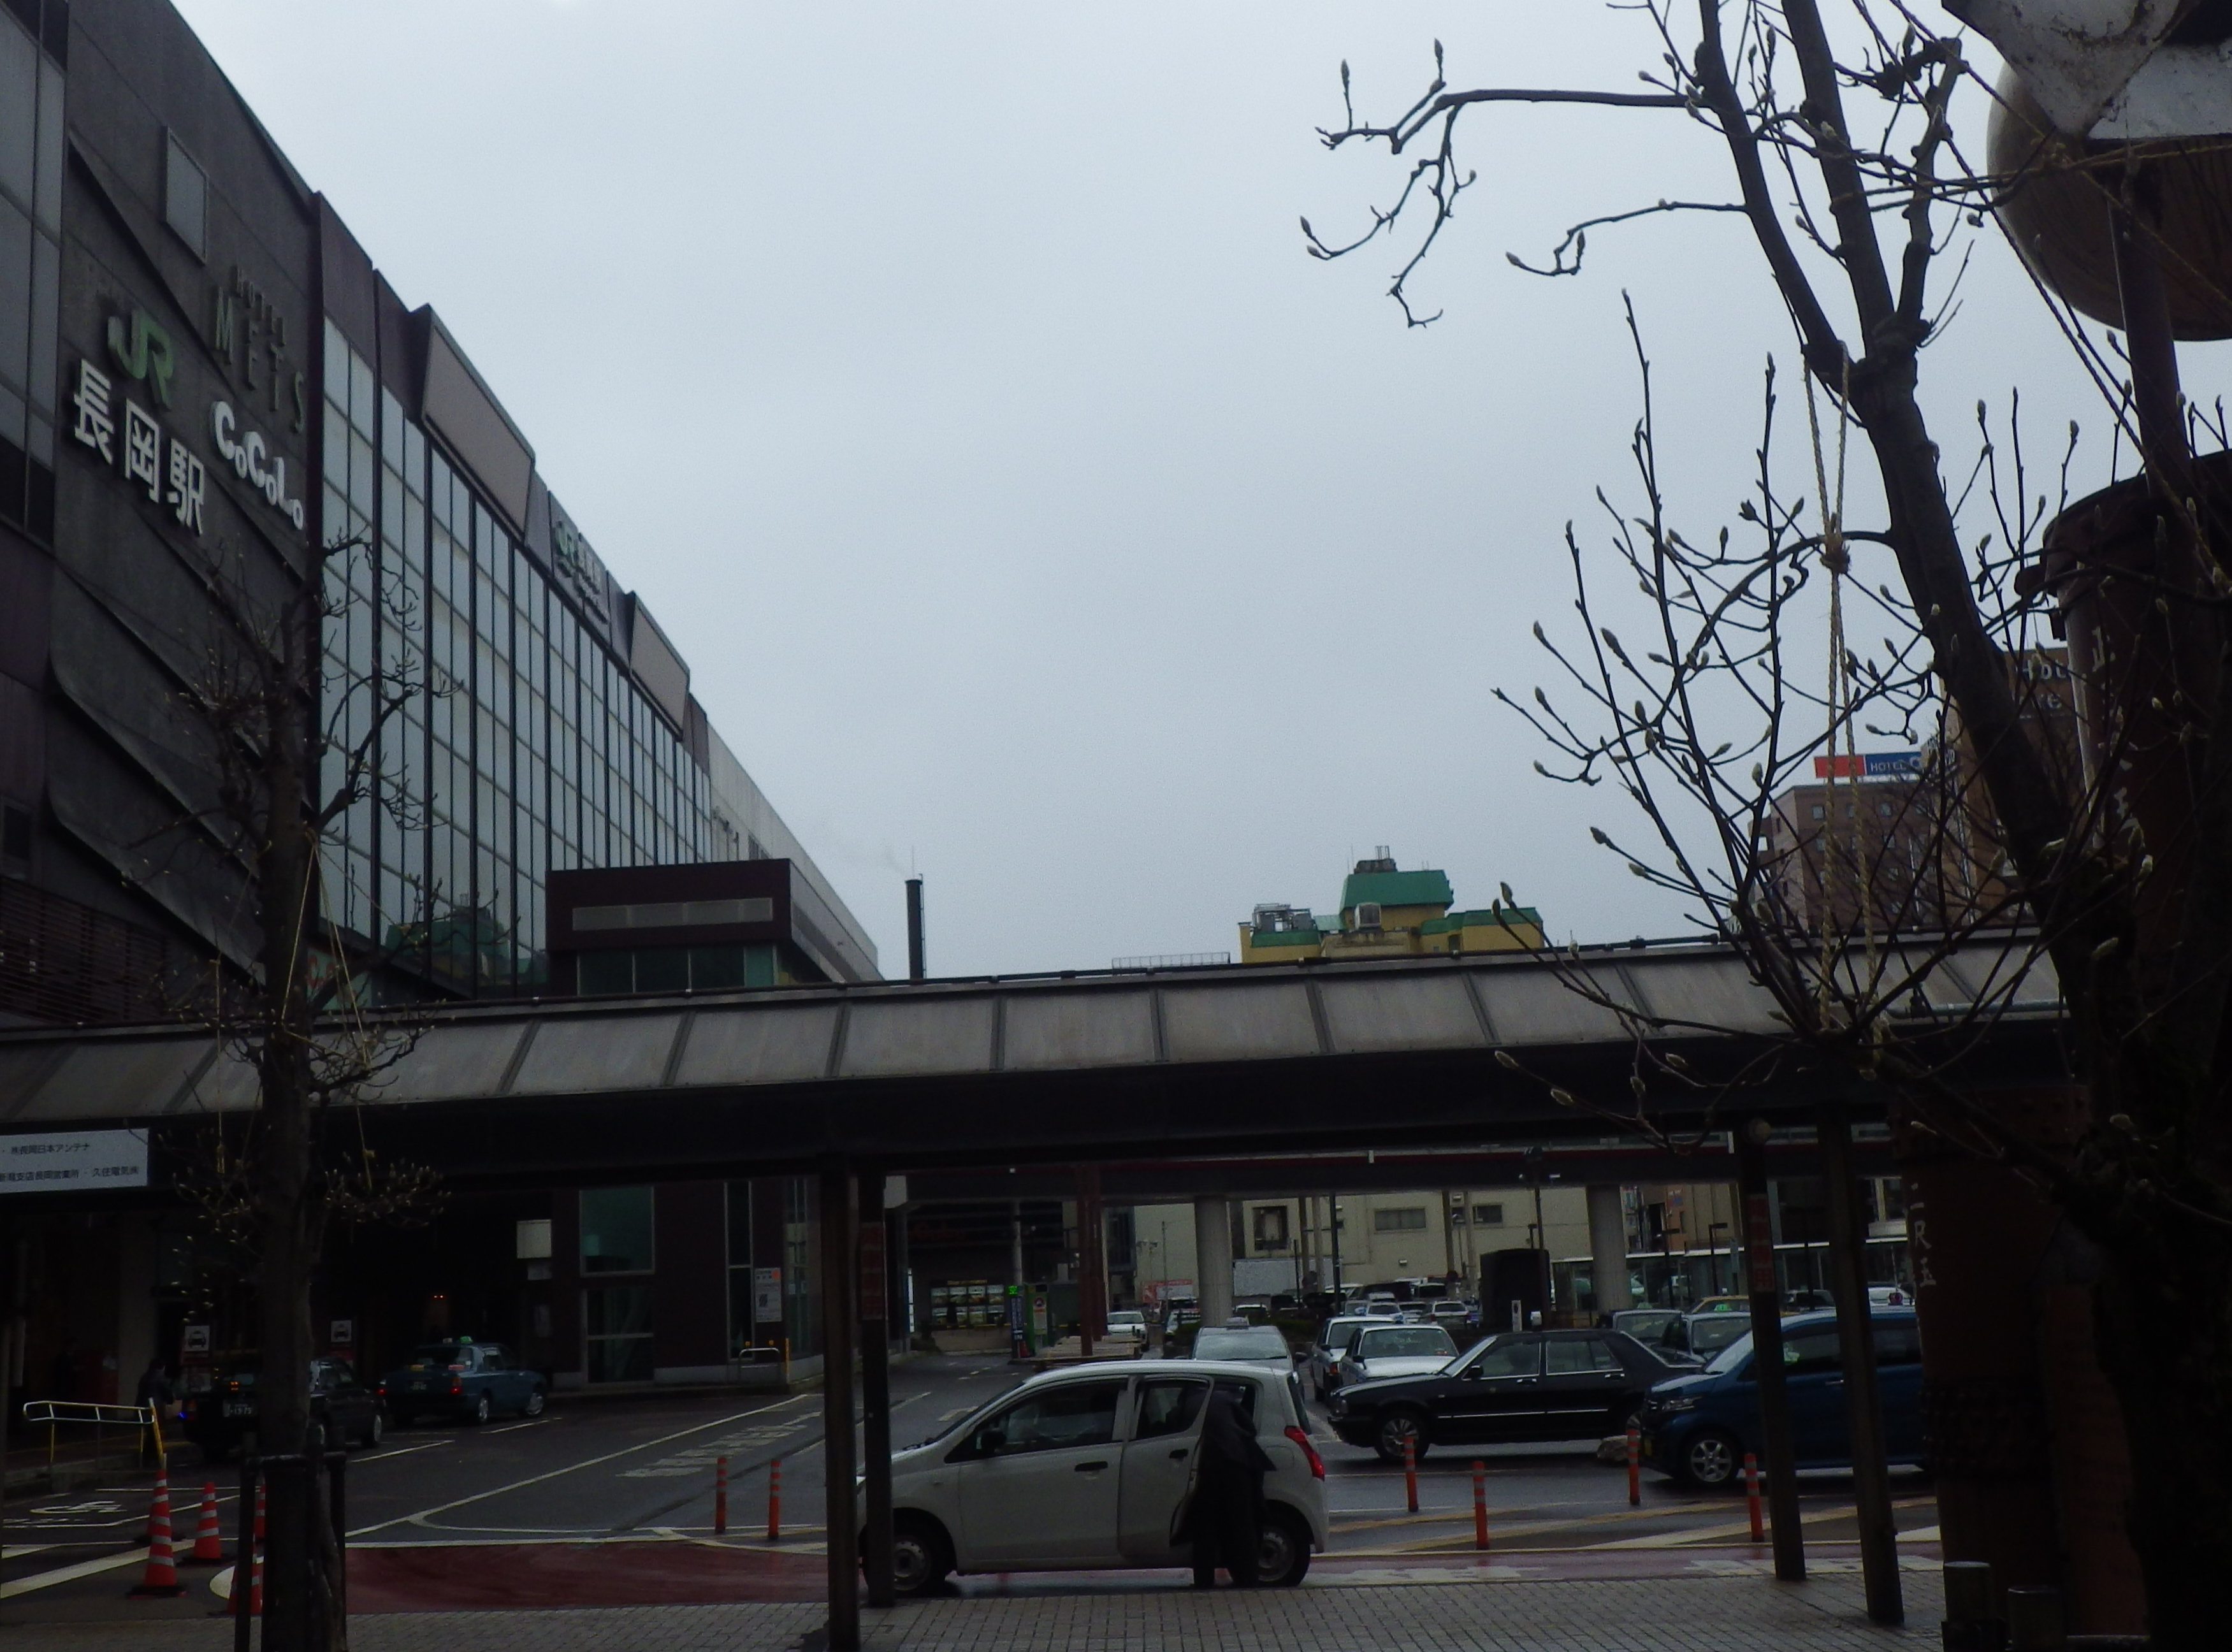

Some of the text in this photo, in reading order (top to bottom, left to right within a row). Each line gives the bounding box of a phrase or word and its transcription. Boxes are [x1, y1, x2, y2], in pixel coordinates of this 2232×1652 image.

[107, 308, 174, 411] JR
[214, 286, 304, 434] METS
[73, 359, 205, 535] 長岡駅
[214, 401, 303, 530] CoCoLo
[1870, 761, 1906, 772] HOTEL
